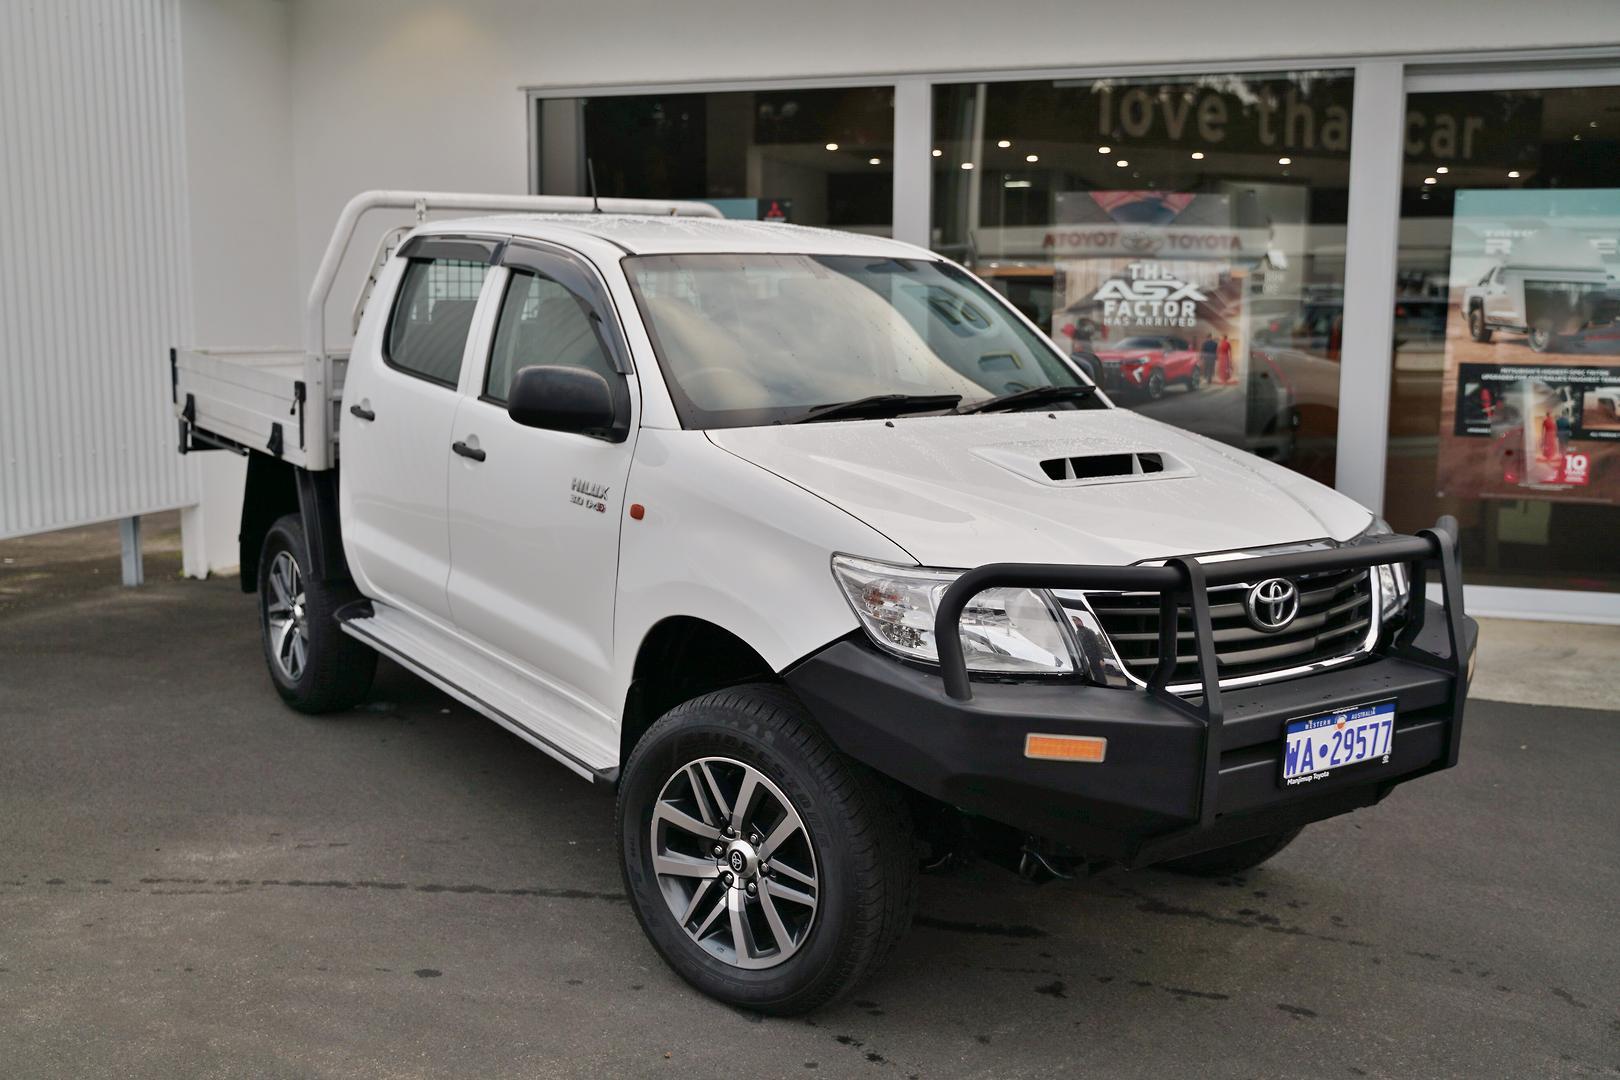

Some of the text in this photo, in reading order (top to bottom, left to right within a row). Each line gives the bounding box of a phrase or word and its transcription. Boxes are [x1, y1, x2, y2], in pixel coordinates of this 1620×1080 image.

[1099, 85, 1484, 158] love tha car
[1093, 280, 1209, 301] ASX
[1104, 300, 1196, 318] FACTOR
[1103, 316, 1197, 327] HAS ARRIVED
[1305, 719, 1331, 730] WESTERN
[1313, 771, 1330, 780] Toyota
